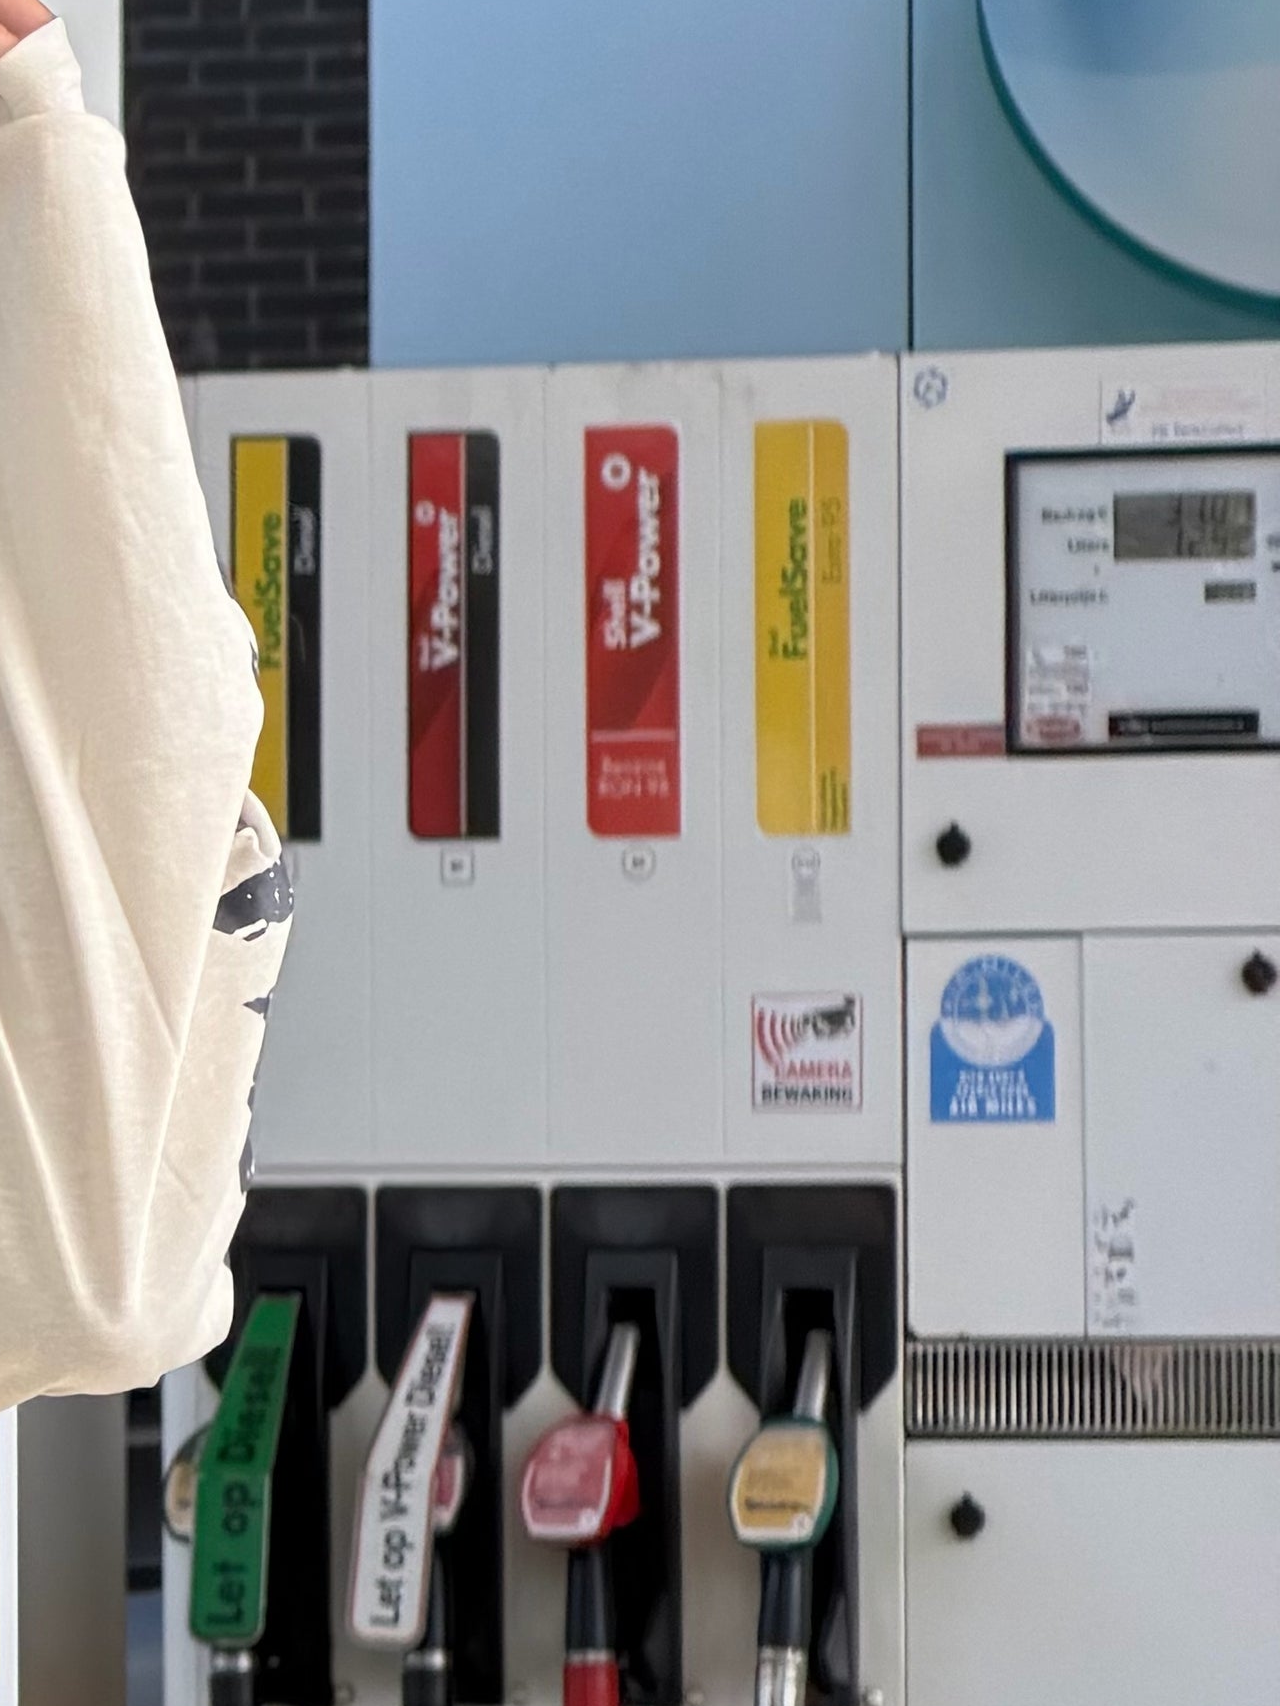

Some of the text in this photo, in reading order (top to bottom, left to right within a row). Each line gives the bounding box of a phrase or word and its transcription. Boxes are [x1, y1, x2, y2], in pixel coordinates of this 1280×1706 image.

[430, 506, 459, 671] V-Power
[630, 466, 661, 650] V-Power
[779, 497, 808, 660] FuelSave
[603, 579, 627, 651] Shell
[220, 1479, 263, 1538] op
[383, 1527, 415, 1570] op
[206, 1559, 246, 1627] Let
[369, 1574, 403, 1629] Let
